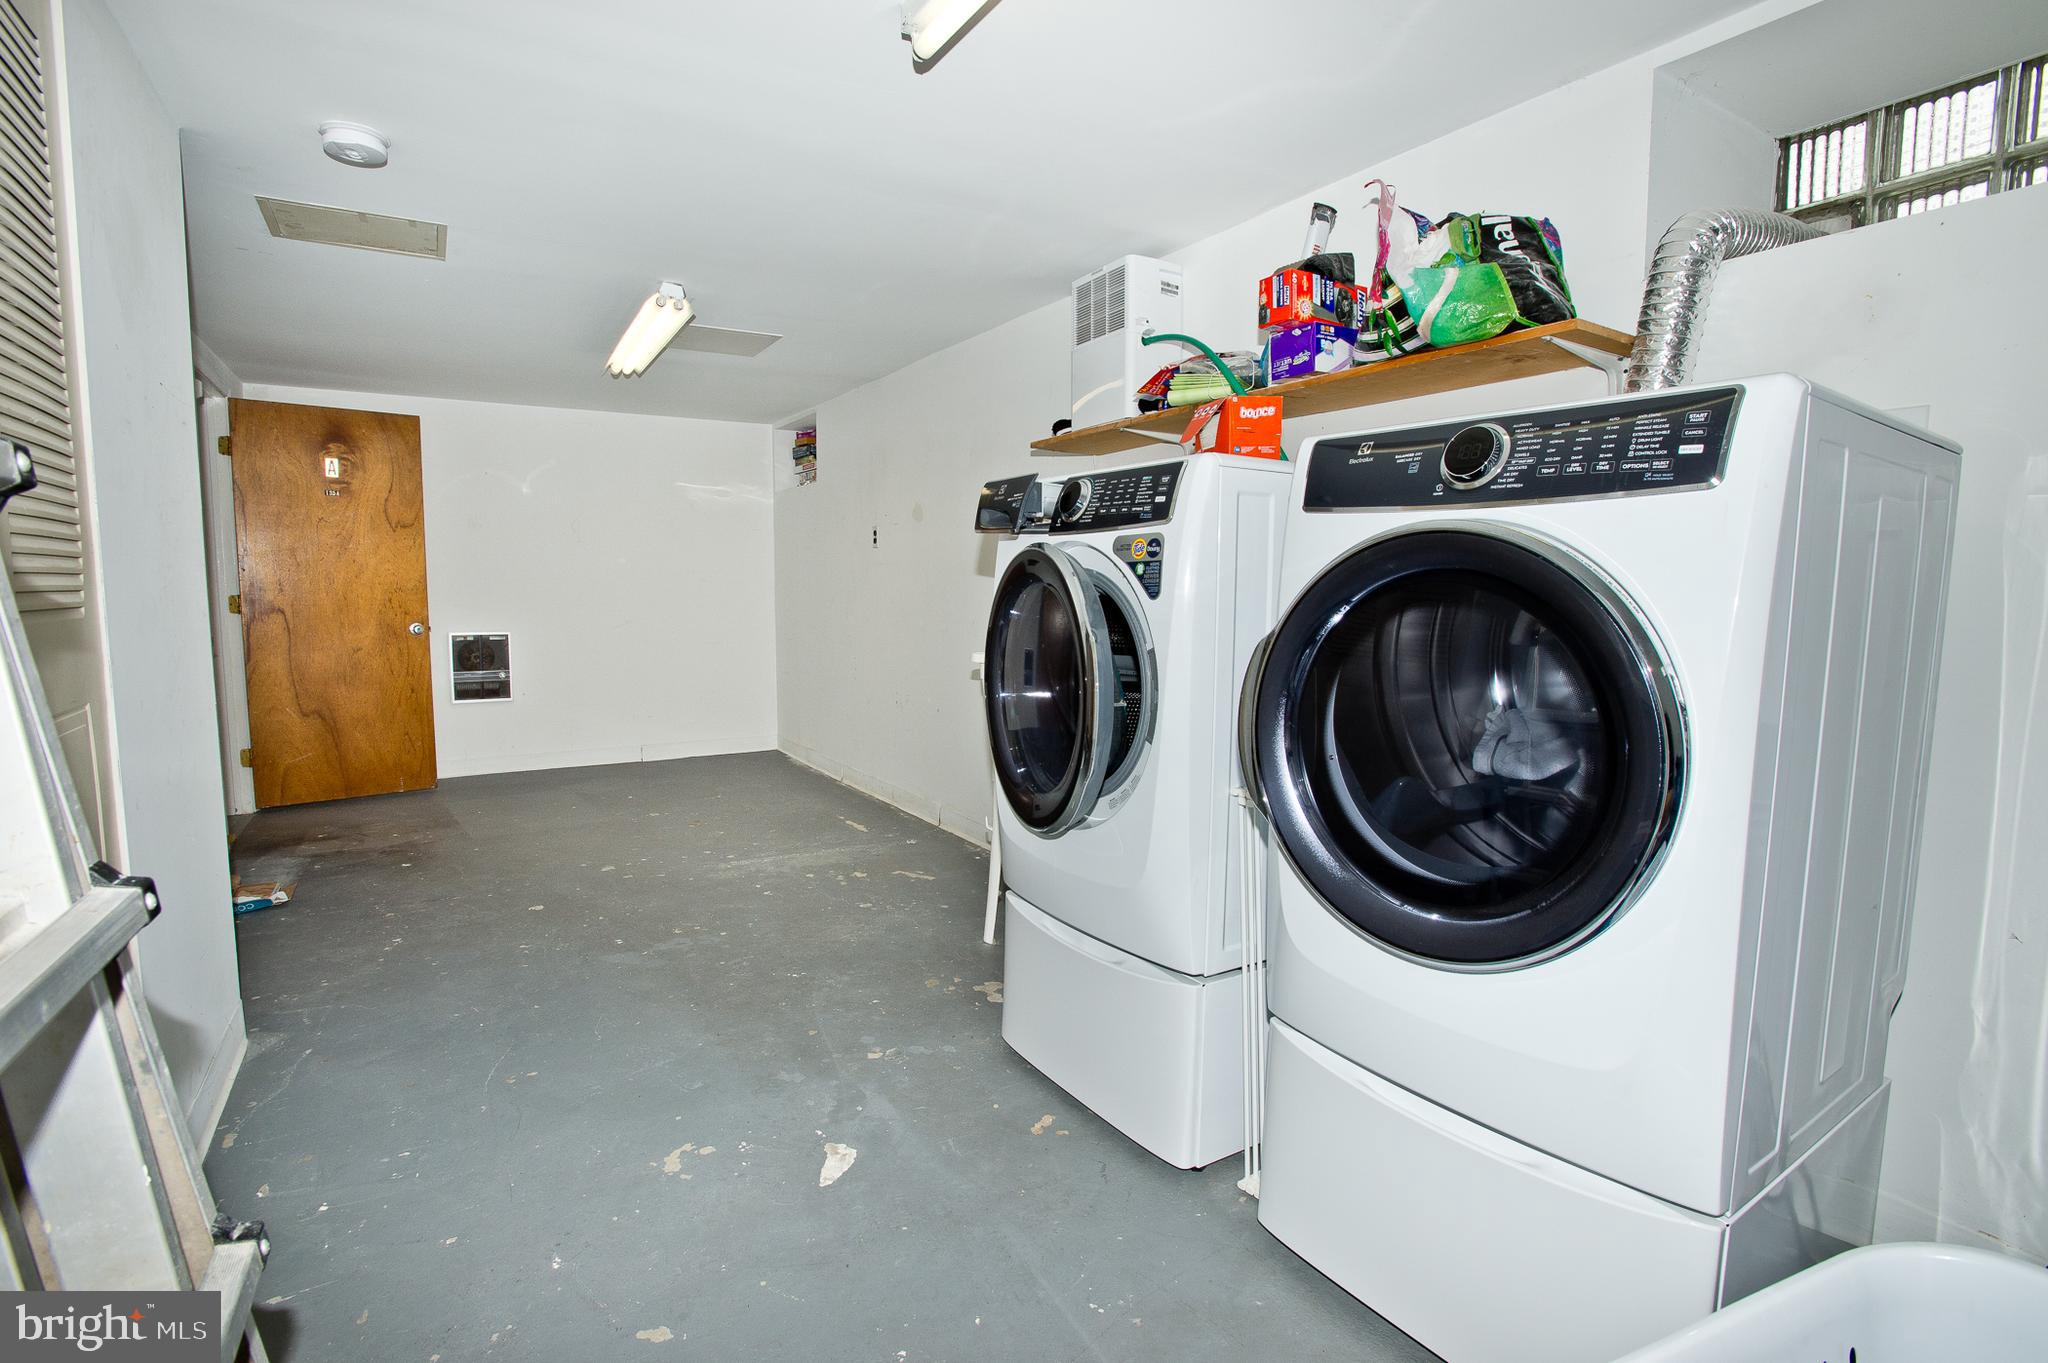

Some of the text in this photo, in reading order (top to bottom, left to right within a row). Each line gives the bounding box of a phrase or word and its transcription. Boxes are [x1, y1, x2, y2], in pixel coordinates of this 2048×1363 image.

[1357, 290, 1366, 327] Hefty
[1240, 405, 1276, 419] bounce
[328, 460, 337, 475] A
[1349, 457, 1374, 465] Electrolux
